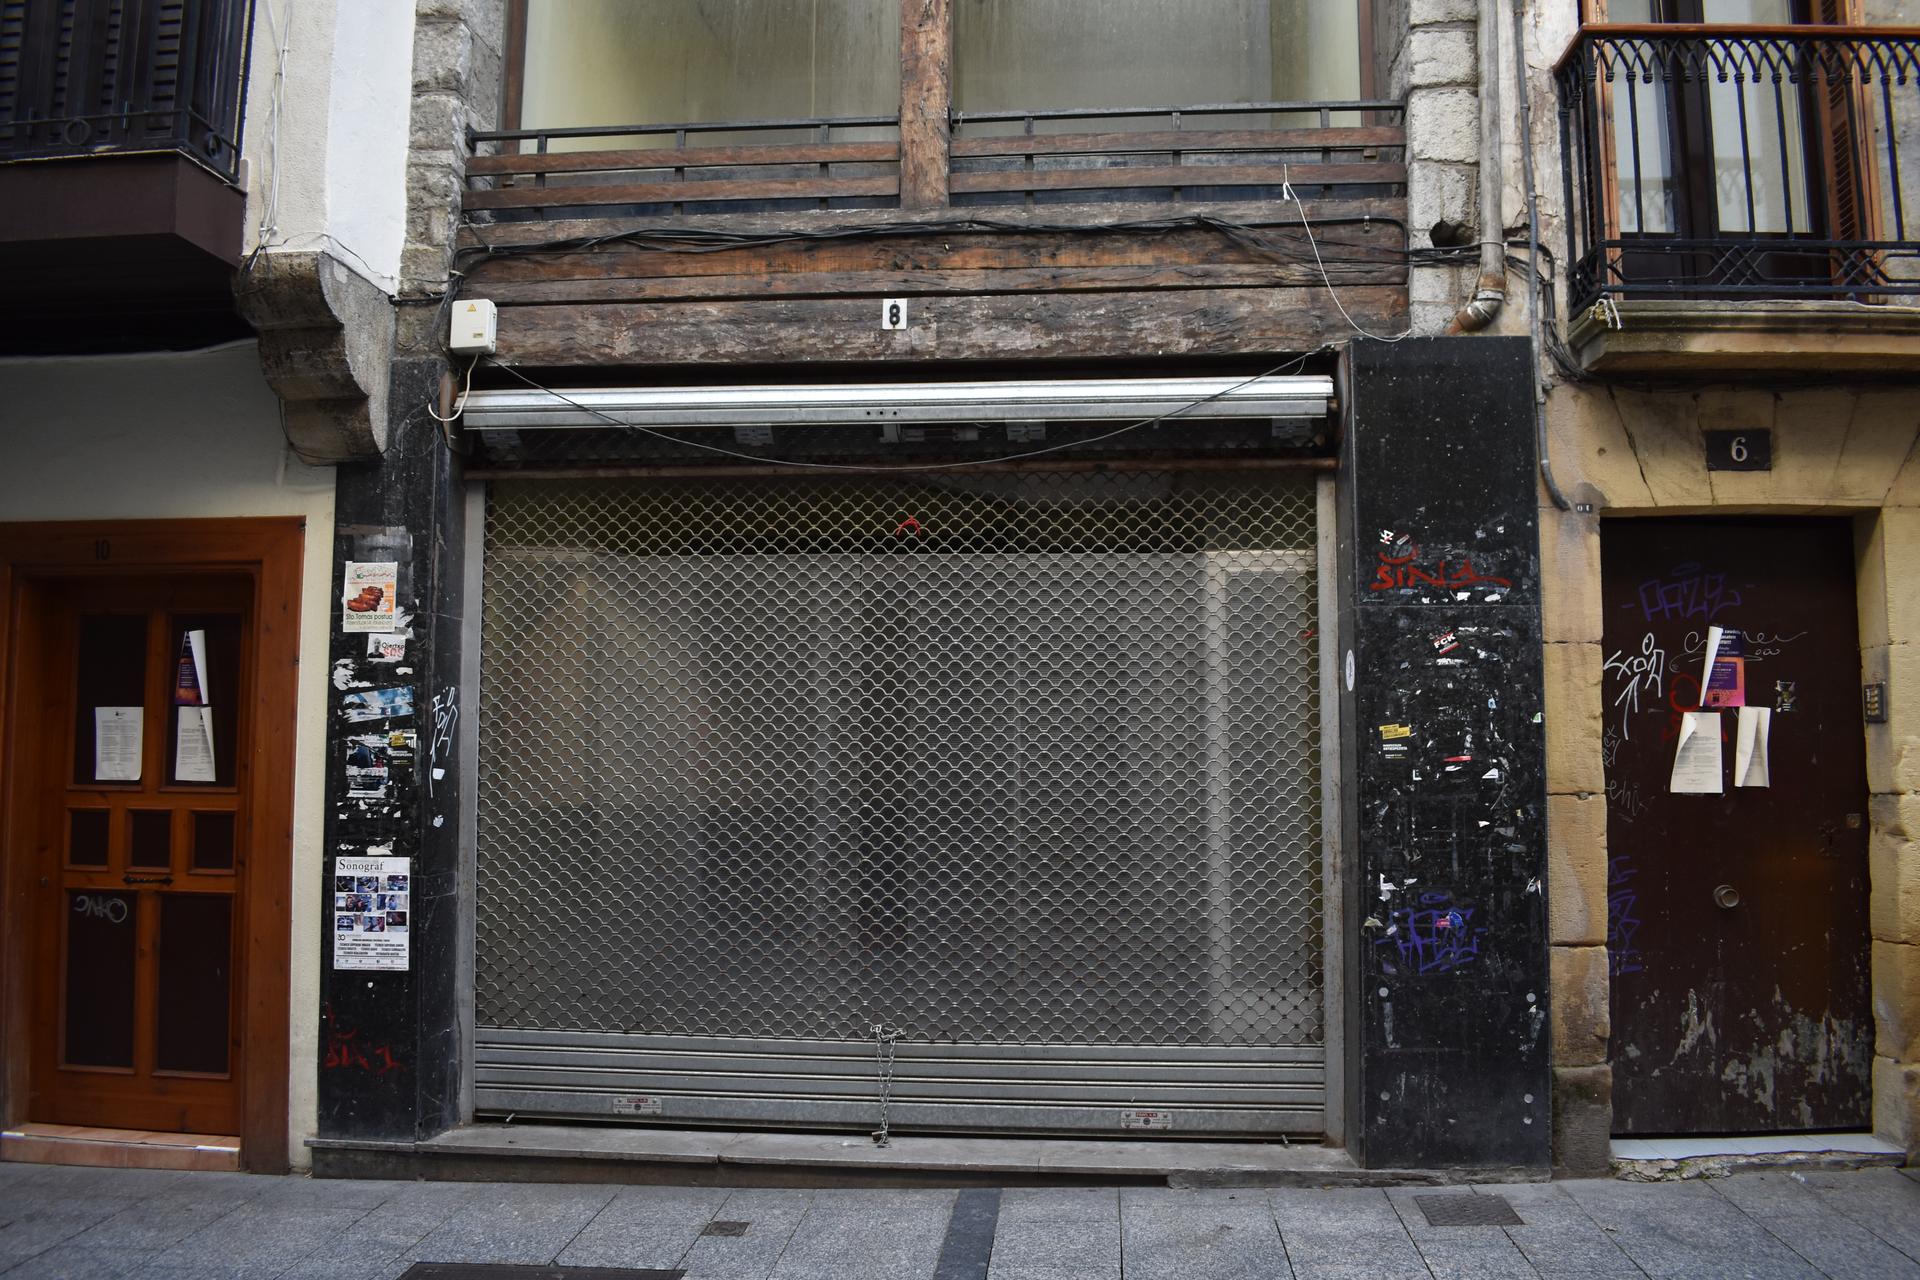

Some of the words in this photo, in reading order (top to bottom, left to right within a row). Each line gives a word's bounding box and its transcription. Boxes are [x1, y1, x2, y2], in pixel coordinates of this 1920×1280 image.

[889, 303, 901, 326] 8
[1731, 436, 1748, 462] 6
[1433, 632, 1457, 650] FCK
[339, 859, 384, 872] Sonograf
